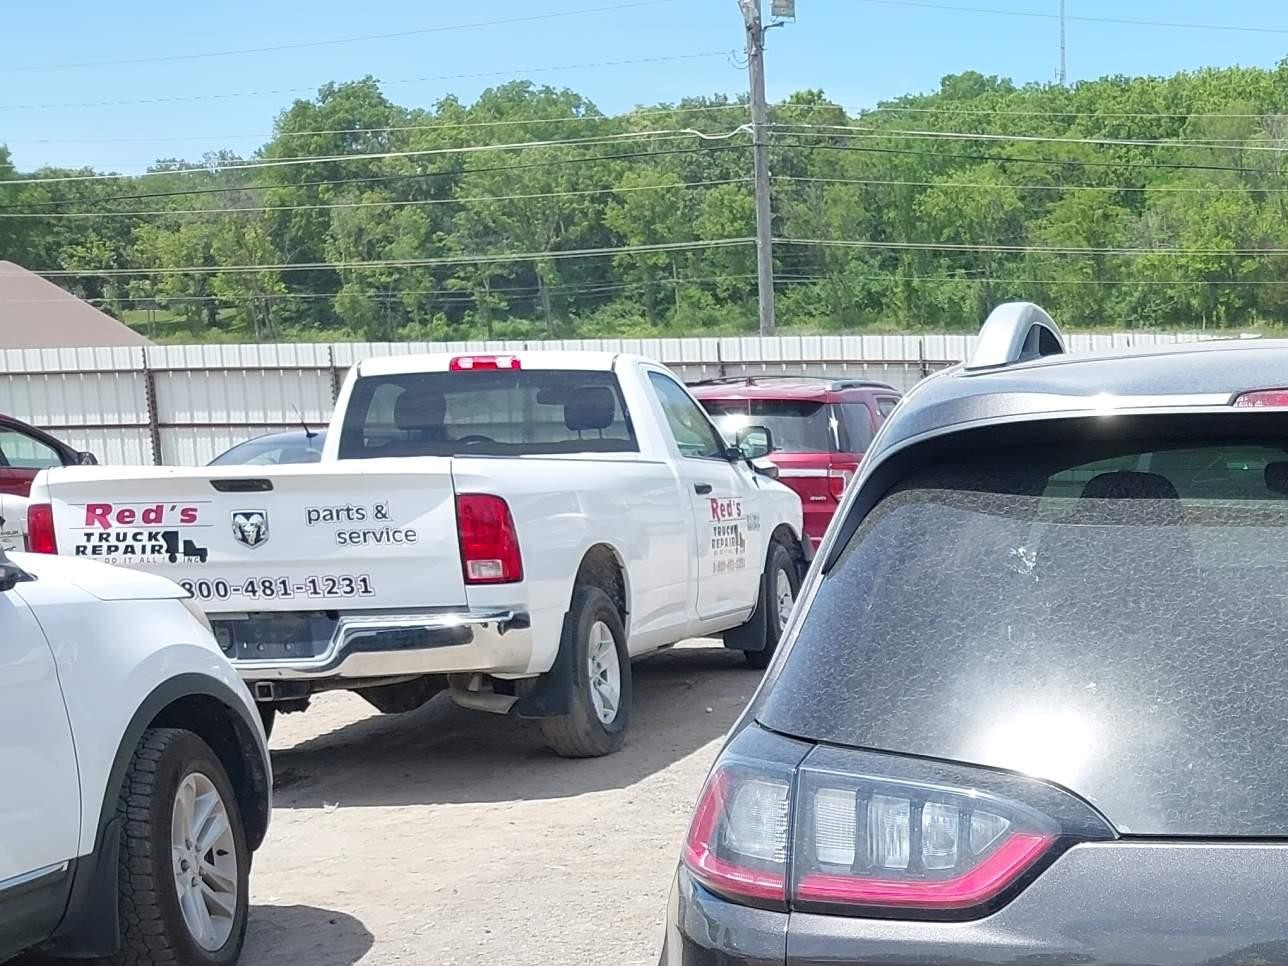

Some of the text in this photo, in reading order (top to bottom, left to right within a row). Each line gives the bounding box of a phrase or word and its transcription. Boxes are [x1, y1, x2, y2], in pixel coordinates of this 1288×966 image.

[85, 503, 199, 531] Red's
[307, 504, 388, 525] parts &
[711, 498, 741, 523] Red's
[83, 531, 162, 543] TRUCK
[336, 527, 417, 545] service
[75, 544, 165, 556] REPAIR
